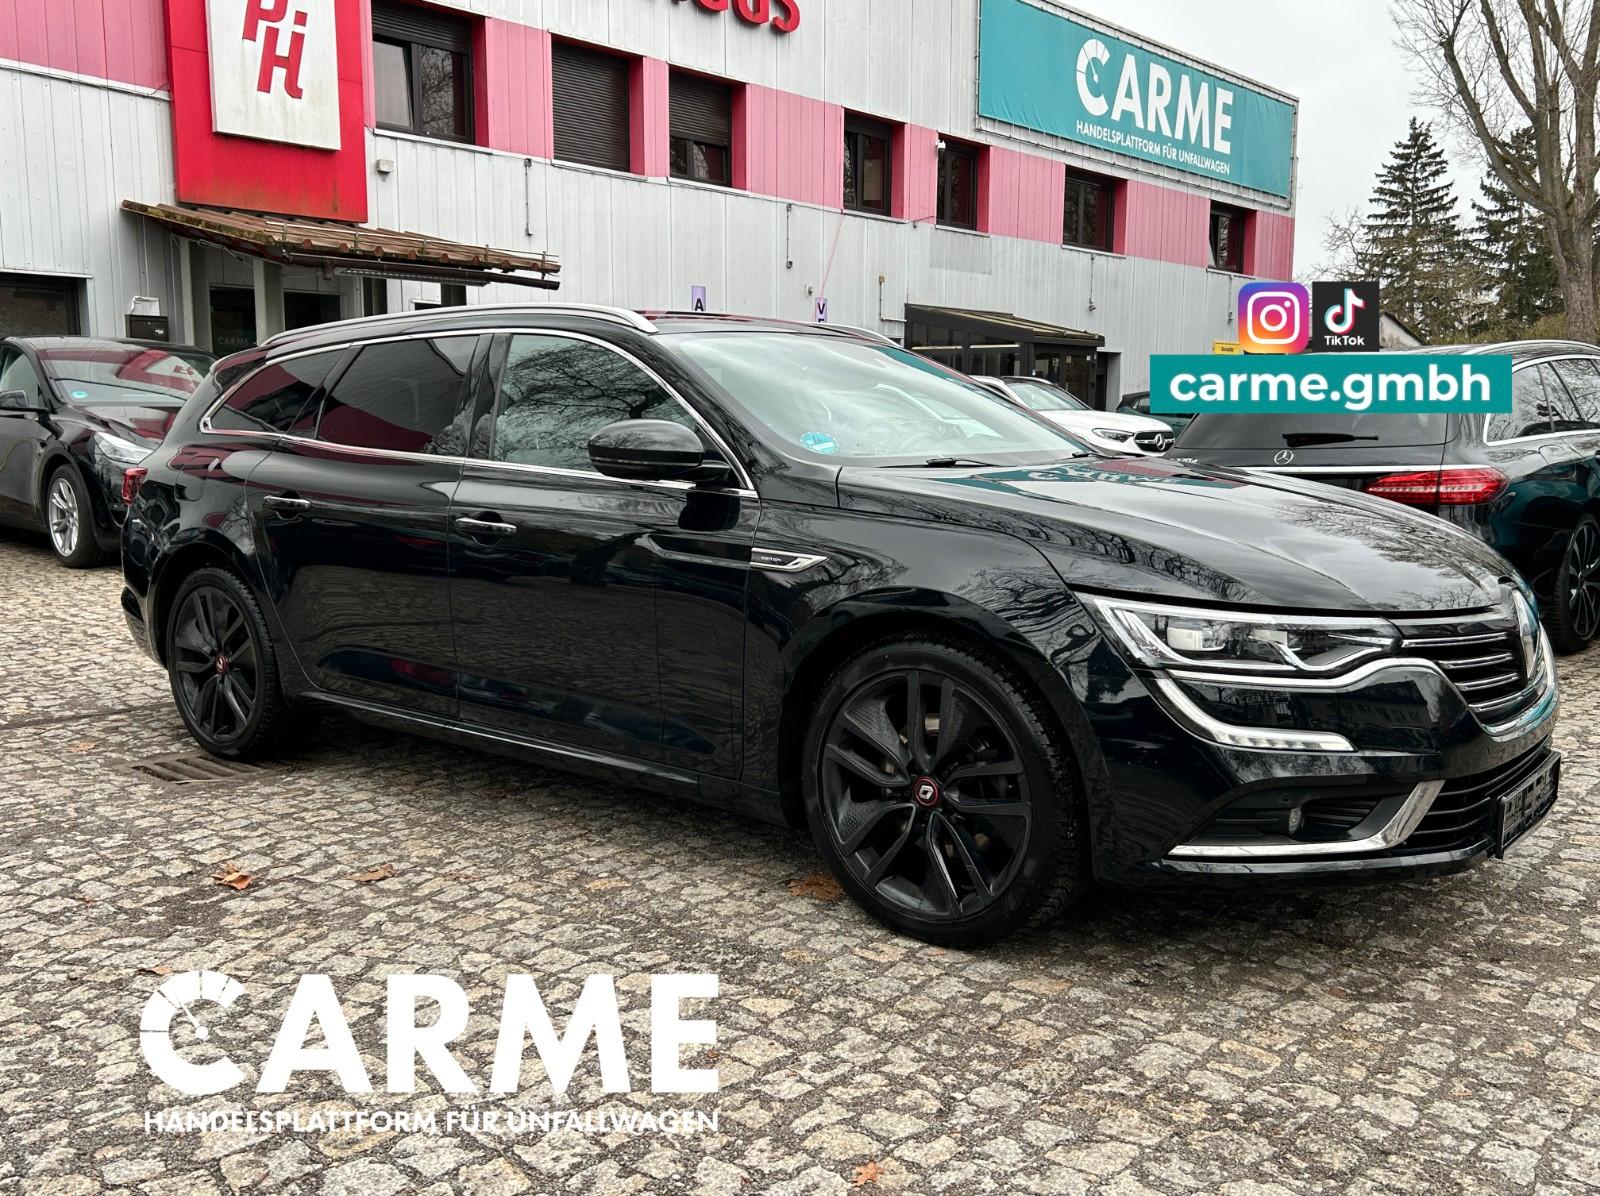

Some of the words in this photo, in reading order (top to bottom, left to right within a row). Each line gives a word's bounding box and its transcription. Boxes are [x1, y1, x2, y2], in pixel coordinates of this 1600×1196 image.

[1076, 39, 1233, 154] CARME
[1076, 120, 1161, 155] HANDELSPLATTFORM
[1162, 143, 1177, 160] FÜR
[1178, 150, 1230, 175] UNFALLWAGEN
